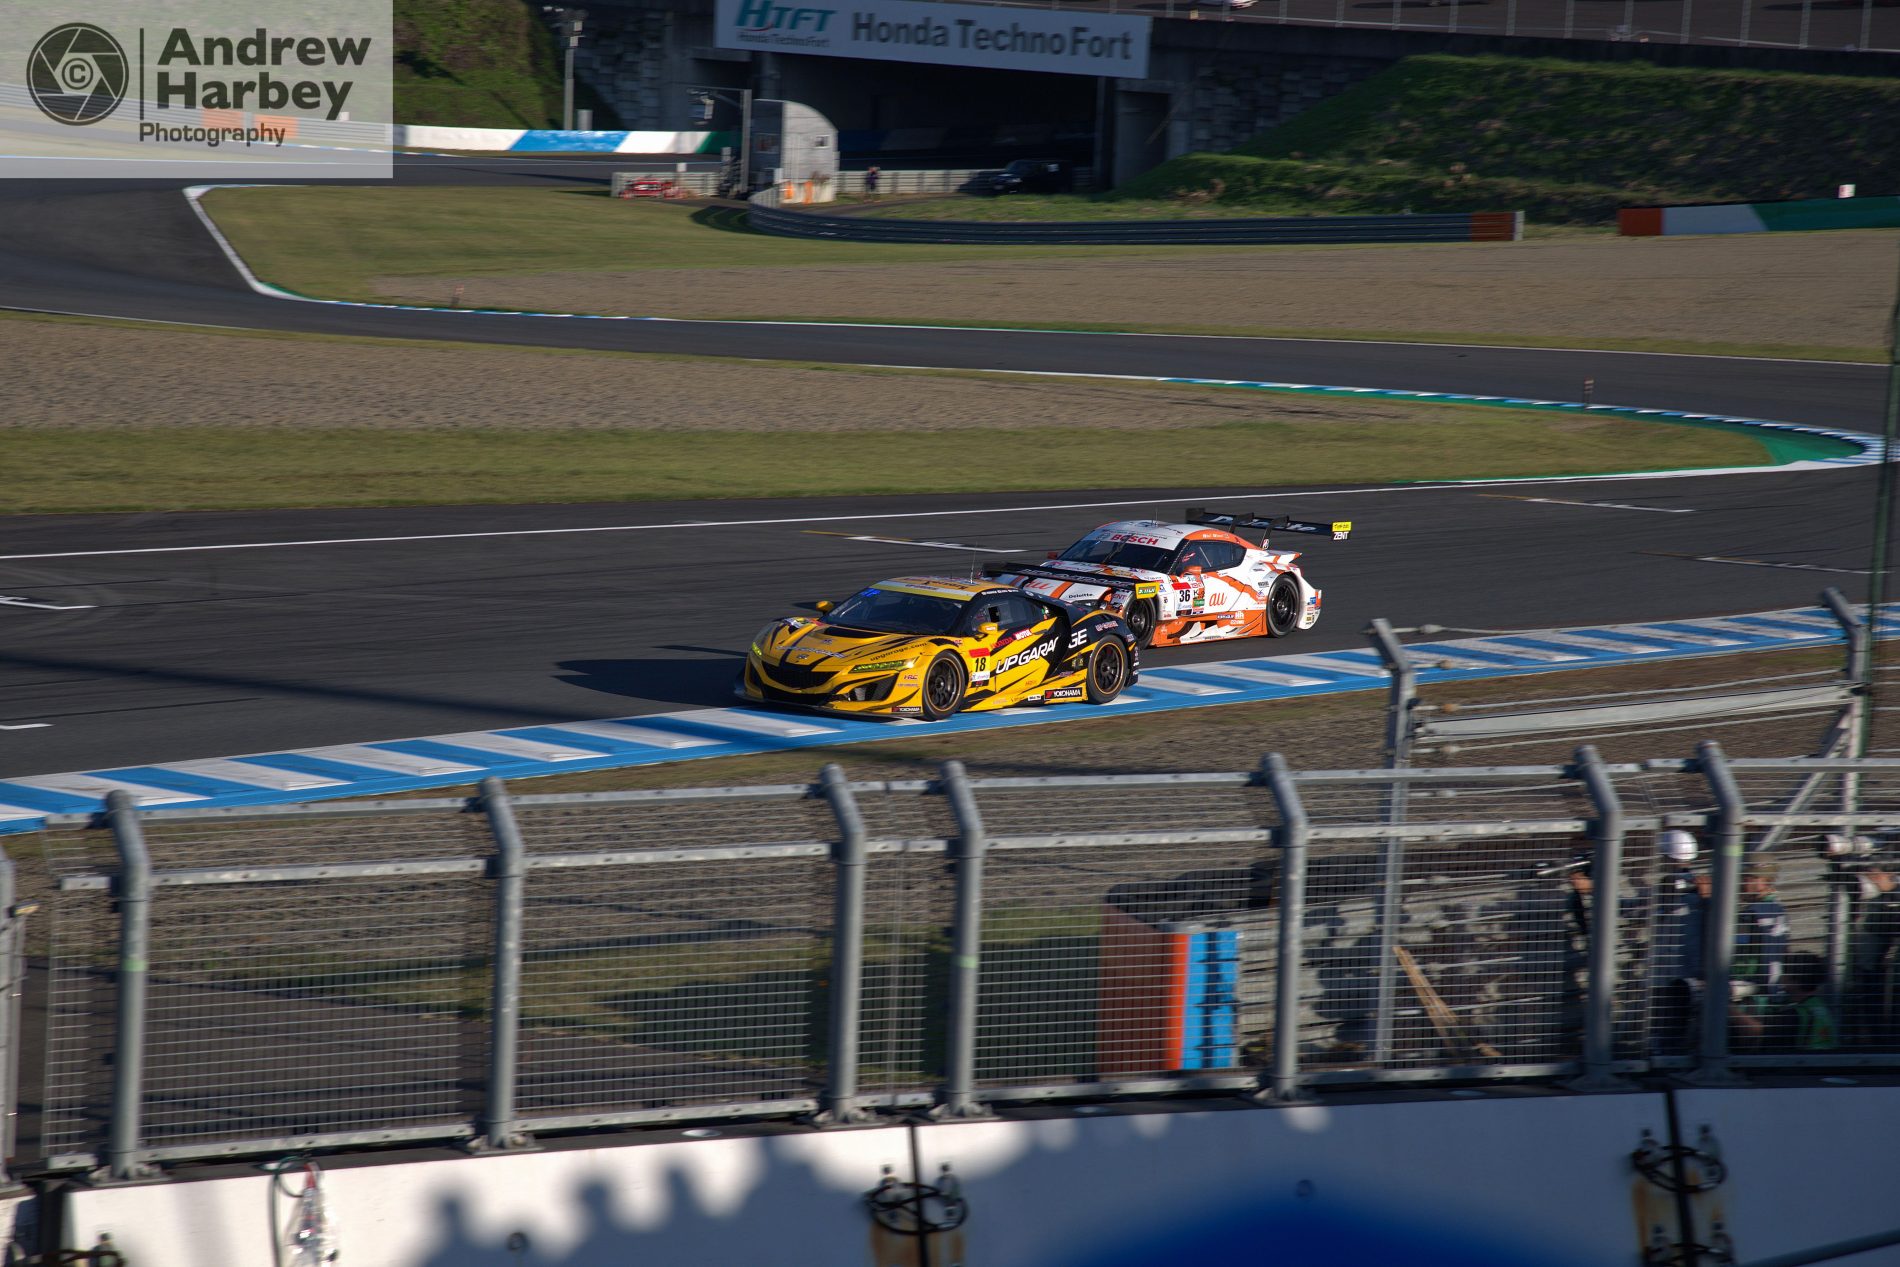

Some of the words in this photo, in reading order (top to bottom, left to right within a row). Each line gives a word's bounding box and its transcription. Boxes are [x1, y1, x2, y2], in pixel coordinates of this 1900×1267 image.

[735, 0, 838, 32] HTFT
[852, 11, 949, 47] Honda
[1111, 533, 1160, 546] BOSCH
[1179, 589, 1191, 603] 36
[1208, 592, 1227, 607] au
[974, 657, 986, 673] 18
